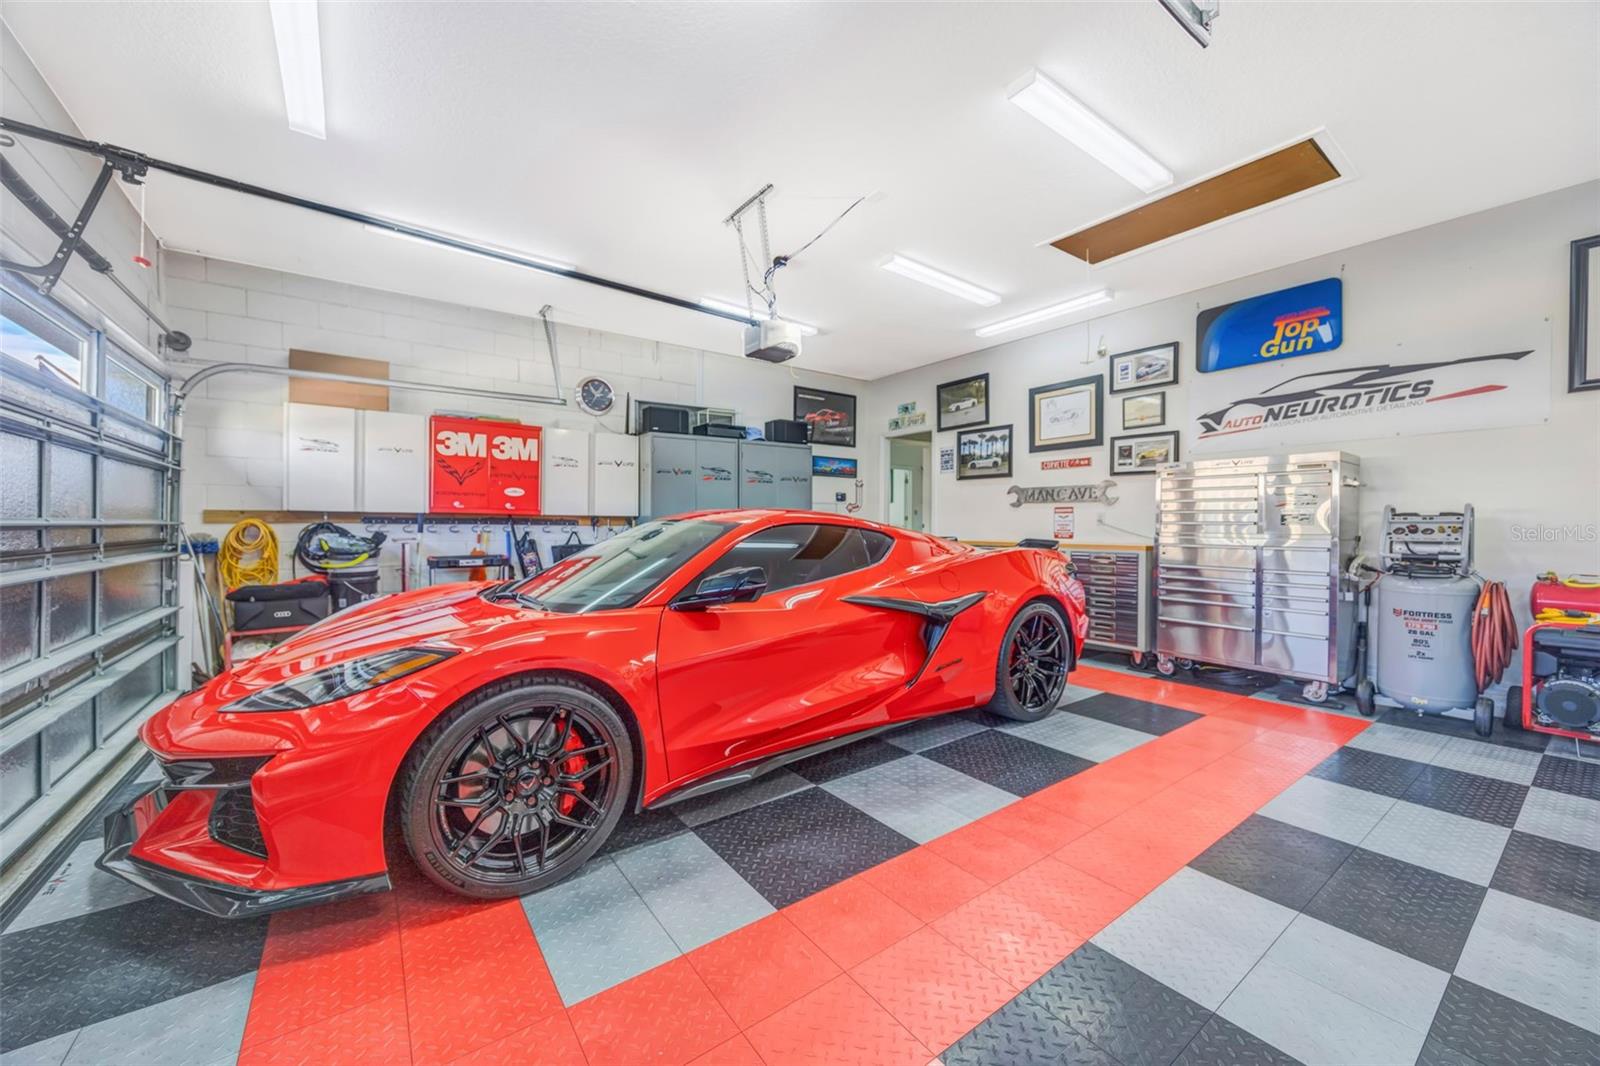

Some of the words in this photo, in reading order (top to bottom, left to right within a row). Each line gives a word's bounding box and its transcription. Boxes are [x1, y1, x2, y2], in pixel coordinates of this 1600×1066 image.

[1273, 315, 1323, 344] Top
[1260, 336, 1314, 358] Gun
[1320, 406, 1374, 420] AUTOMOTIVE
[1377, 400, 1425, 412] DETAILING
[436, 431, 487, 458] 3M
[491, 436, 539, 461] 3M
[1403, 609, 1453, 619] FORTRESS
